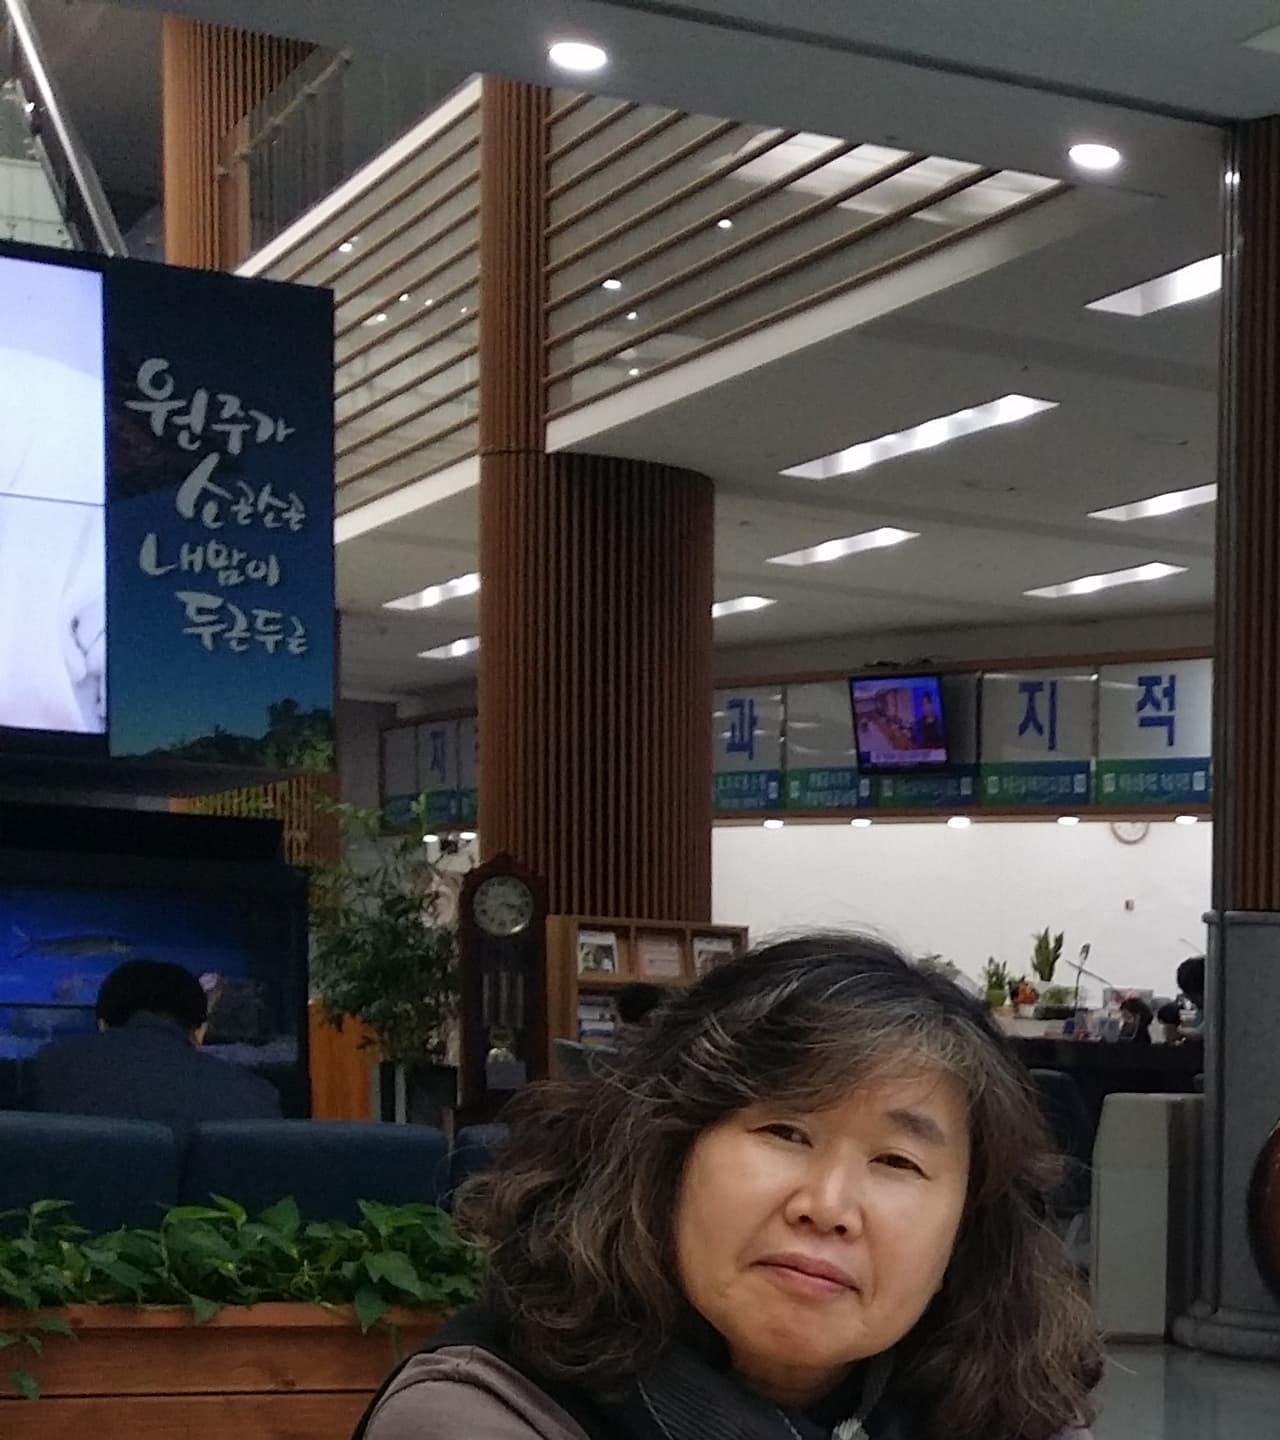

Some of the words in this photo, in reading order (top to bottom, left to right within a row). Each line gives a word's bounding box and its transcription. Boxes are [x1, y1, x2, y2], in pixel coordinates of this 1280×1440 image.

[124, 357, 294, 455] 원주가
[174, 591, 309, 654] 두근두근
[1017, 680, 1058, 752] 지
[1136, 674, 1178, 748] 적
